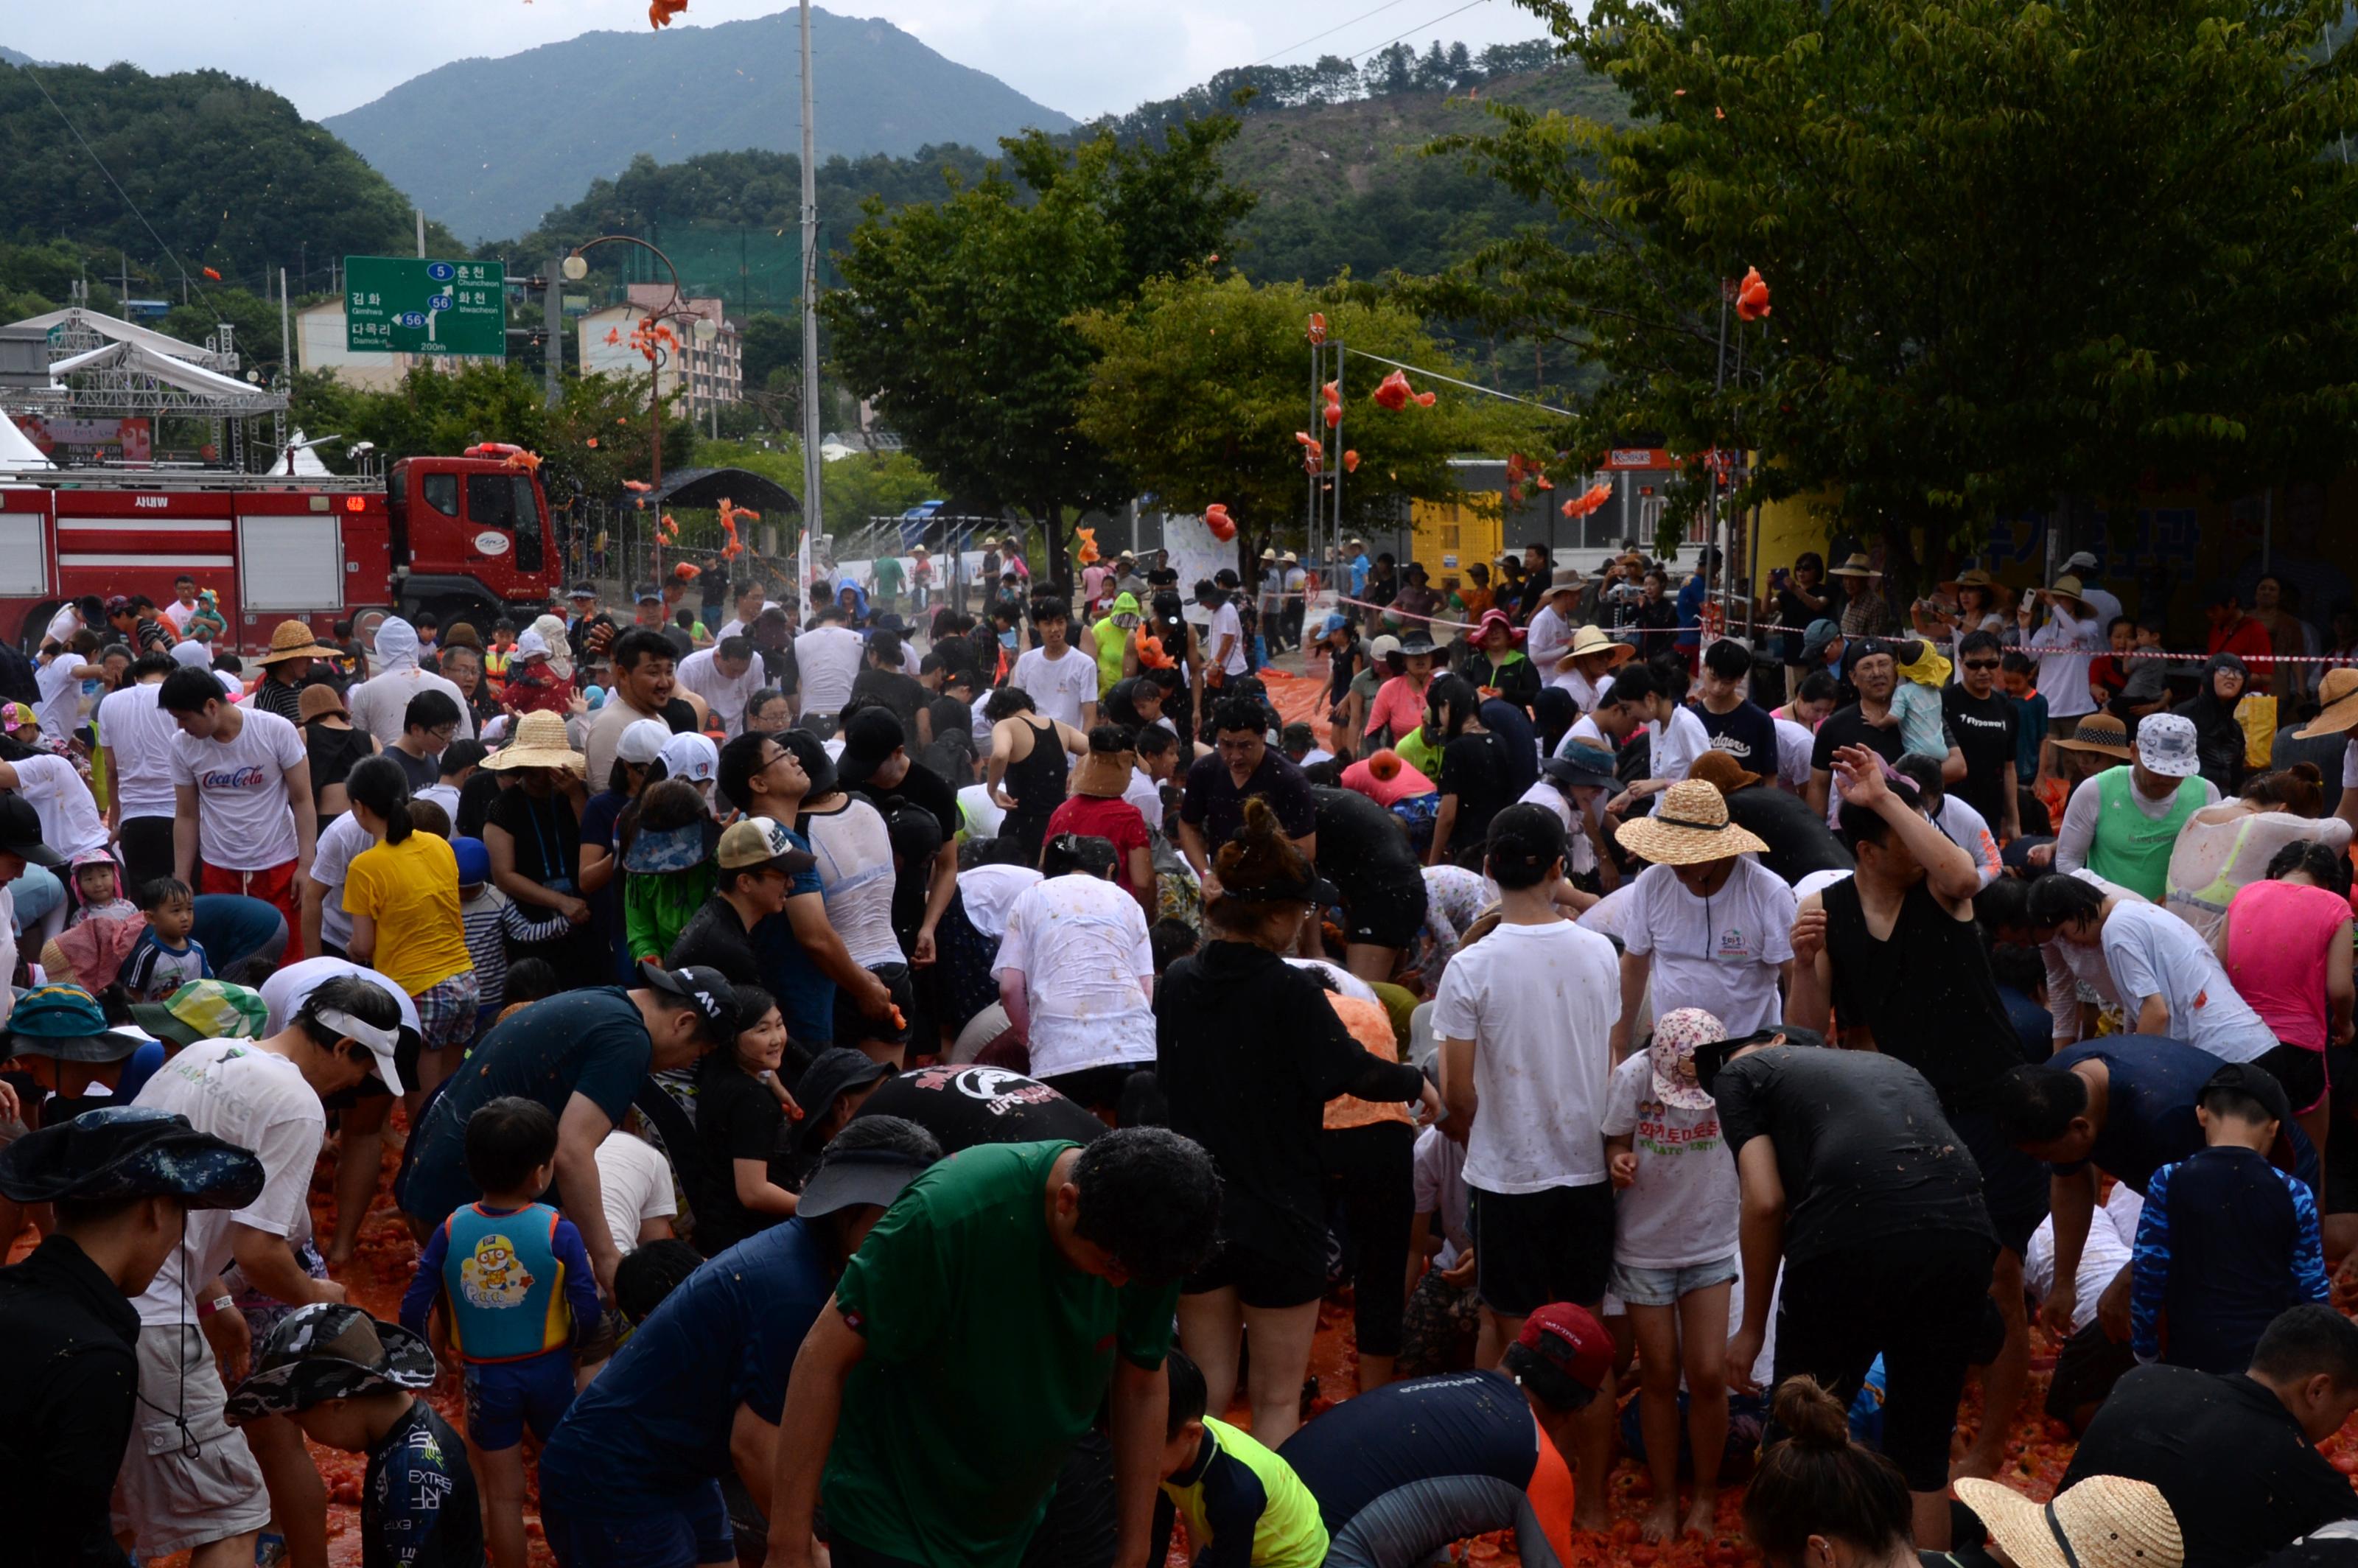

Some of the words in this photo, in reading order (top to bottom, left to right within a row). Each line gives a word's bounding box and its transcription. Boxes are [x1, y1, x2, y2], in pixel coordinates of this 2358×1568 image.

[436, 266, 445, 277] 5
[458, 265, 484, 279] 춘천
[458, 279, 500, 287] Chuncheon
[352, 293, 381, 305] 김화
[433, 298, 448, 309] 56
[458, 292, 486, 304] 화천
[352, 308, 383, 316] Gimhwa
[623, 306, 632, 321] 7
[406, 315, 421, 326] 56
[352, 323, 391, 336] 다목리
[421, 343, 447, 351] 200m
[1707, 731, 1750, 757] odgers
